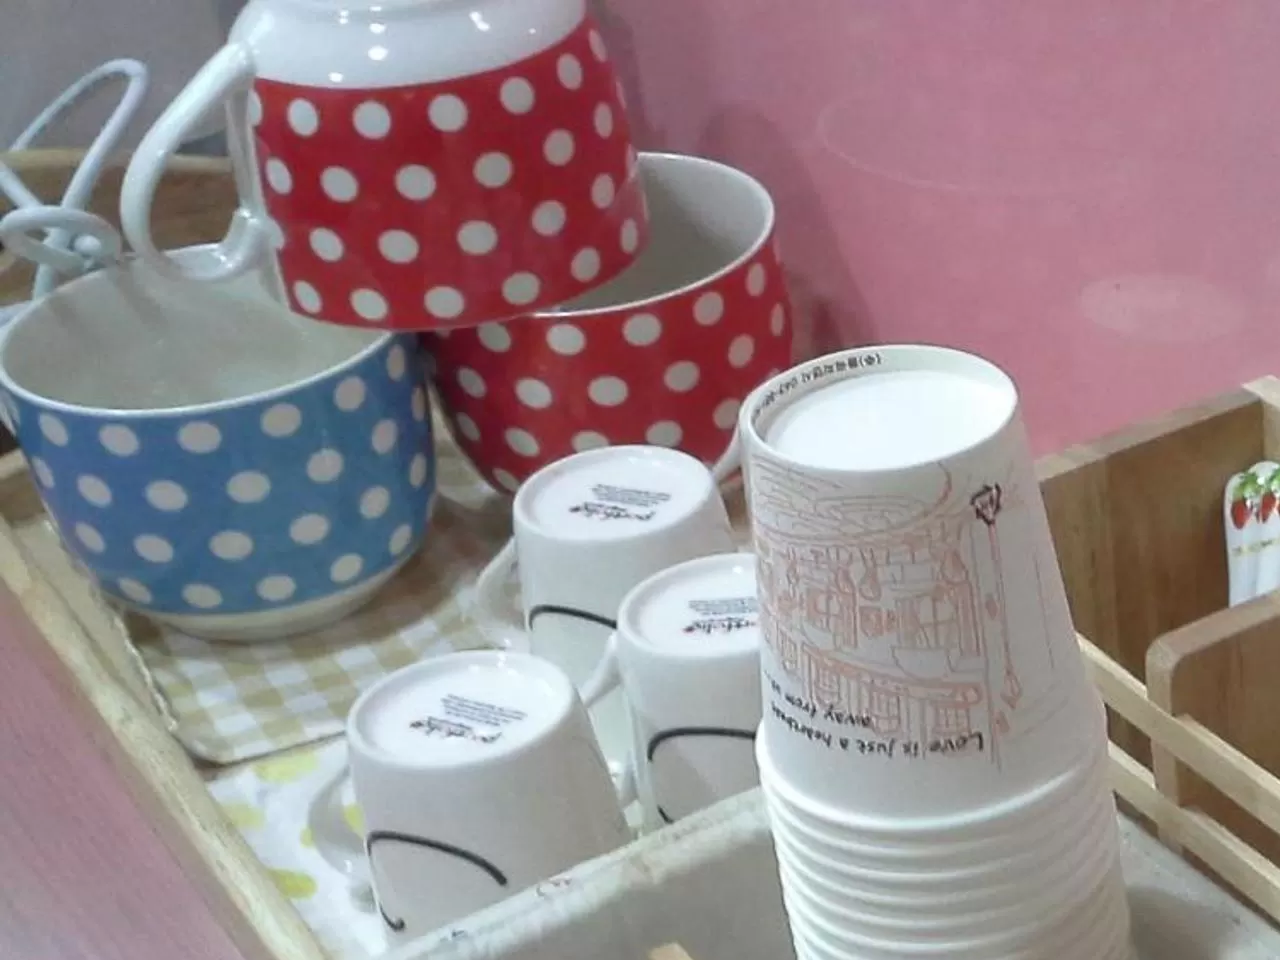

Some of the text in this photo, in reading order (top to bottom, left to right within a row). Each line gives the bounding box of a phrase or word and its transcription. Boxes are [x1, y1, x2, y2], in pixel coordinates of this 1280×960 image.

[823, 704, 873, 729] away
[838, 738, 850, 751] a
[855, 737, 897, 758] just
[902, 740, 920, 758] is
[928, 731, 985, 753] Love
